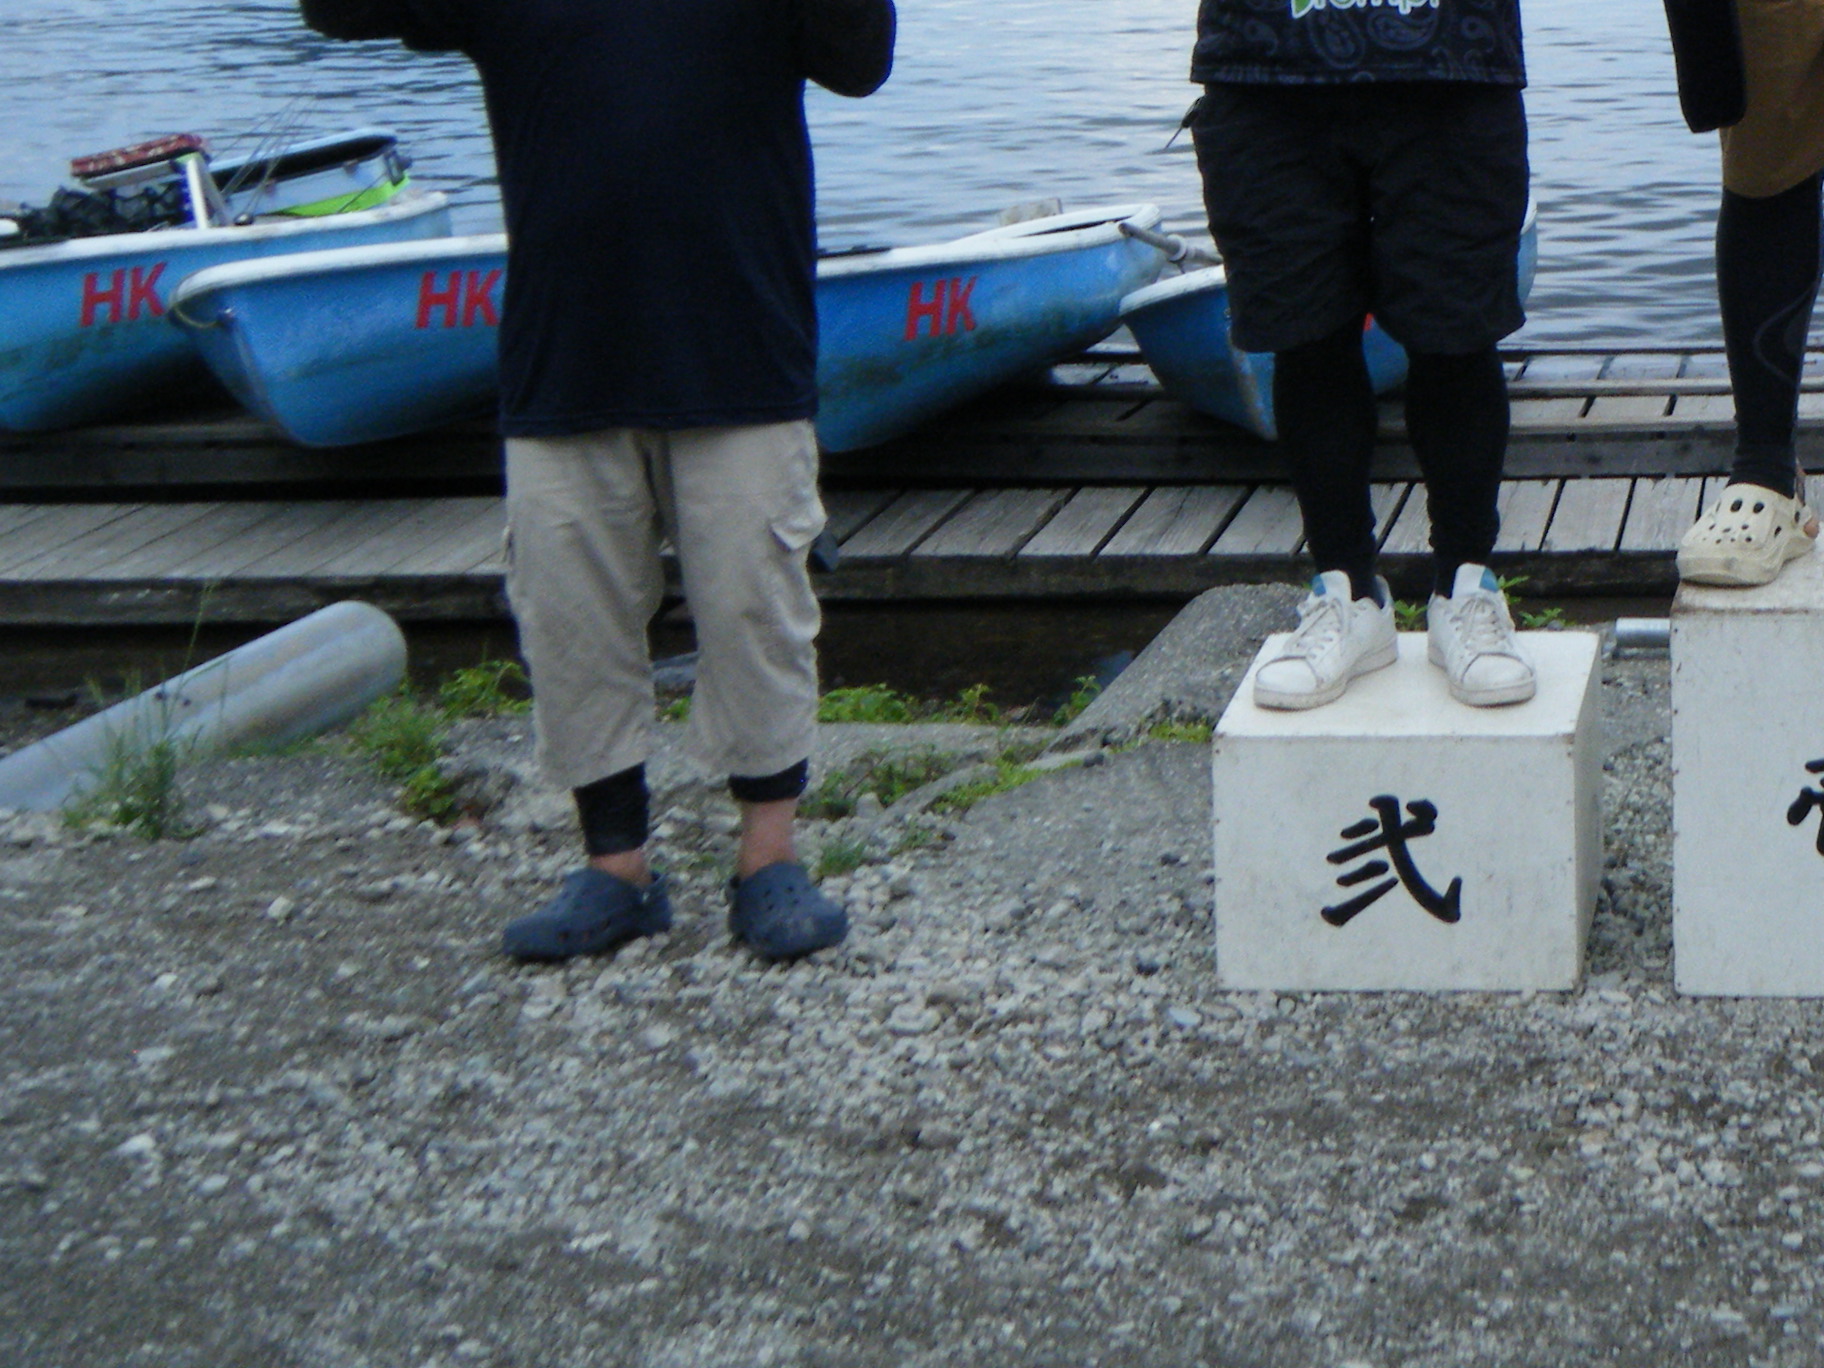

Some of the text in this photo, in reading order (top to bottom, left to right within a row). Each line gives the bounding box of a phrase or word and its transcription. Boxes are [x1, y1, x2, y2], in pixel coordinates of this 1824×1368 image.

[80, 261, 168, 328] HK
[415, 269, 502, 329] HK
[903, 275, 978, 342] HK
[1320, 794, 1463, 927] 弐
